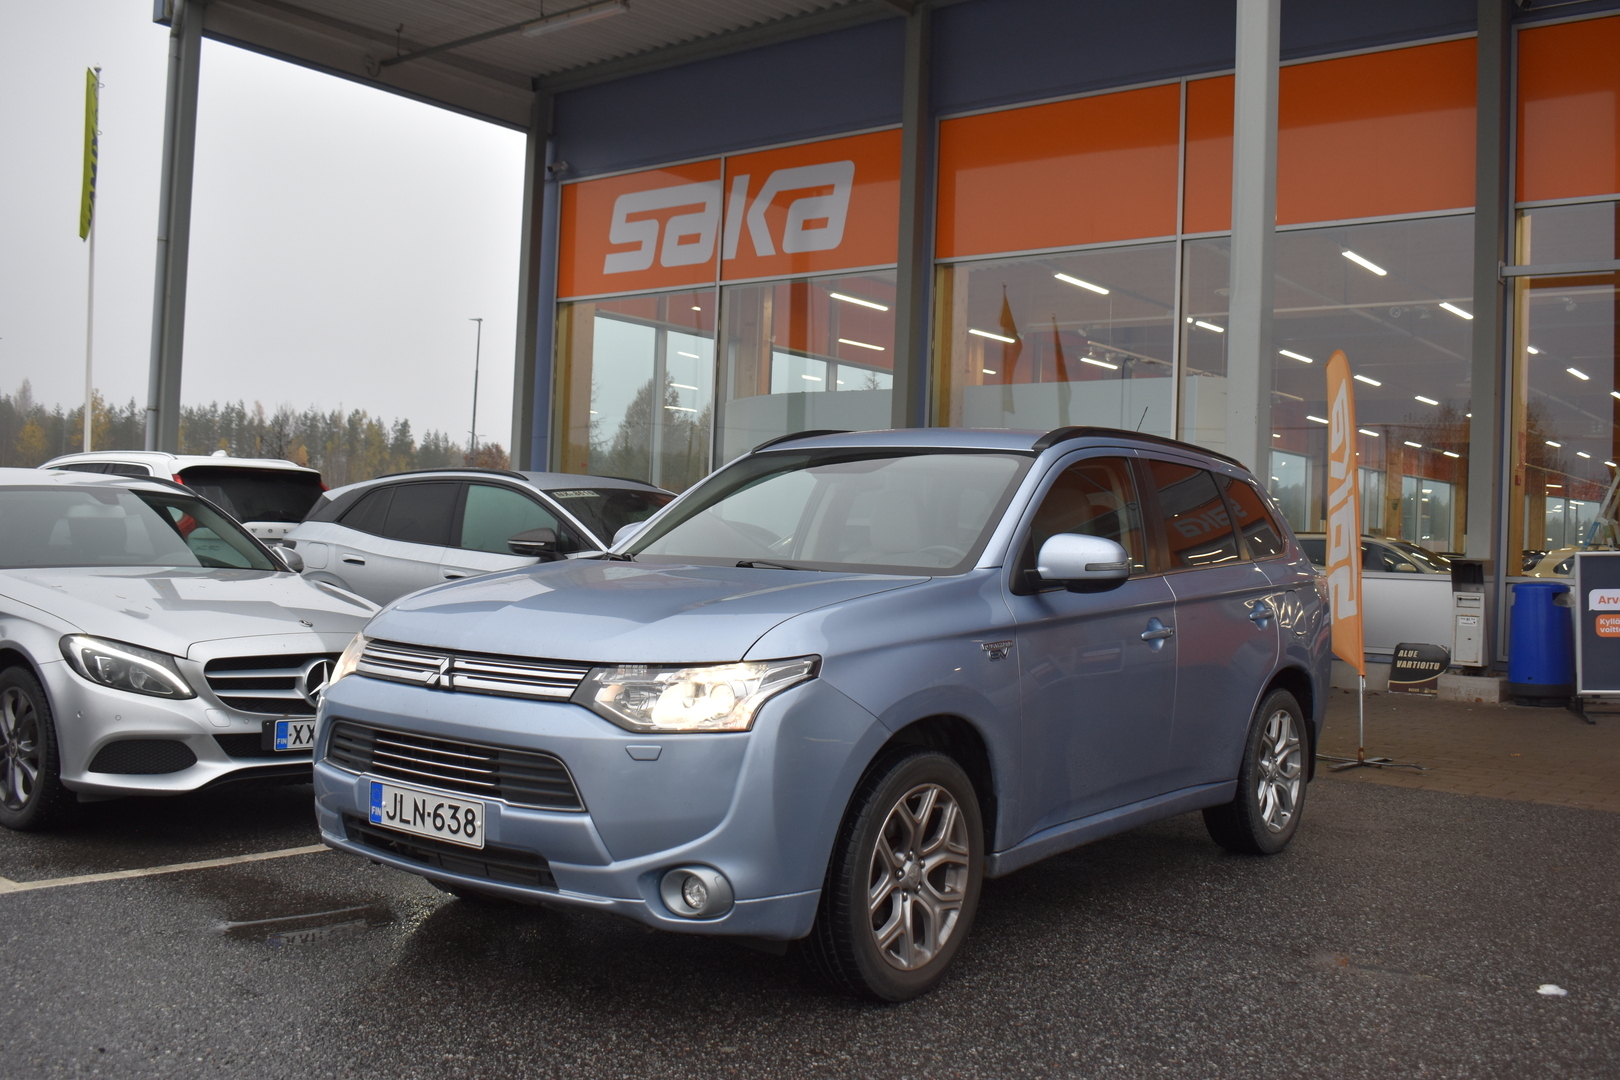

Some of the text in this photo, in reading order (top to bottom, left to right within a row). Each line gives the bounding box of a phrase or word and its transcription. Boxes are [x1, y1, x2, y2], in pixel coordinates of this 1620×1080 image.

[1598, 595, 1620, 604] Arv
[1397, 660, 1440, 670] VARTIOITU
[292, 724, 316, 745] XX
[371, 806, 381, 816] FIN
[386, 793, 476, 838] JLN-638
